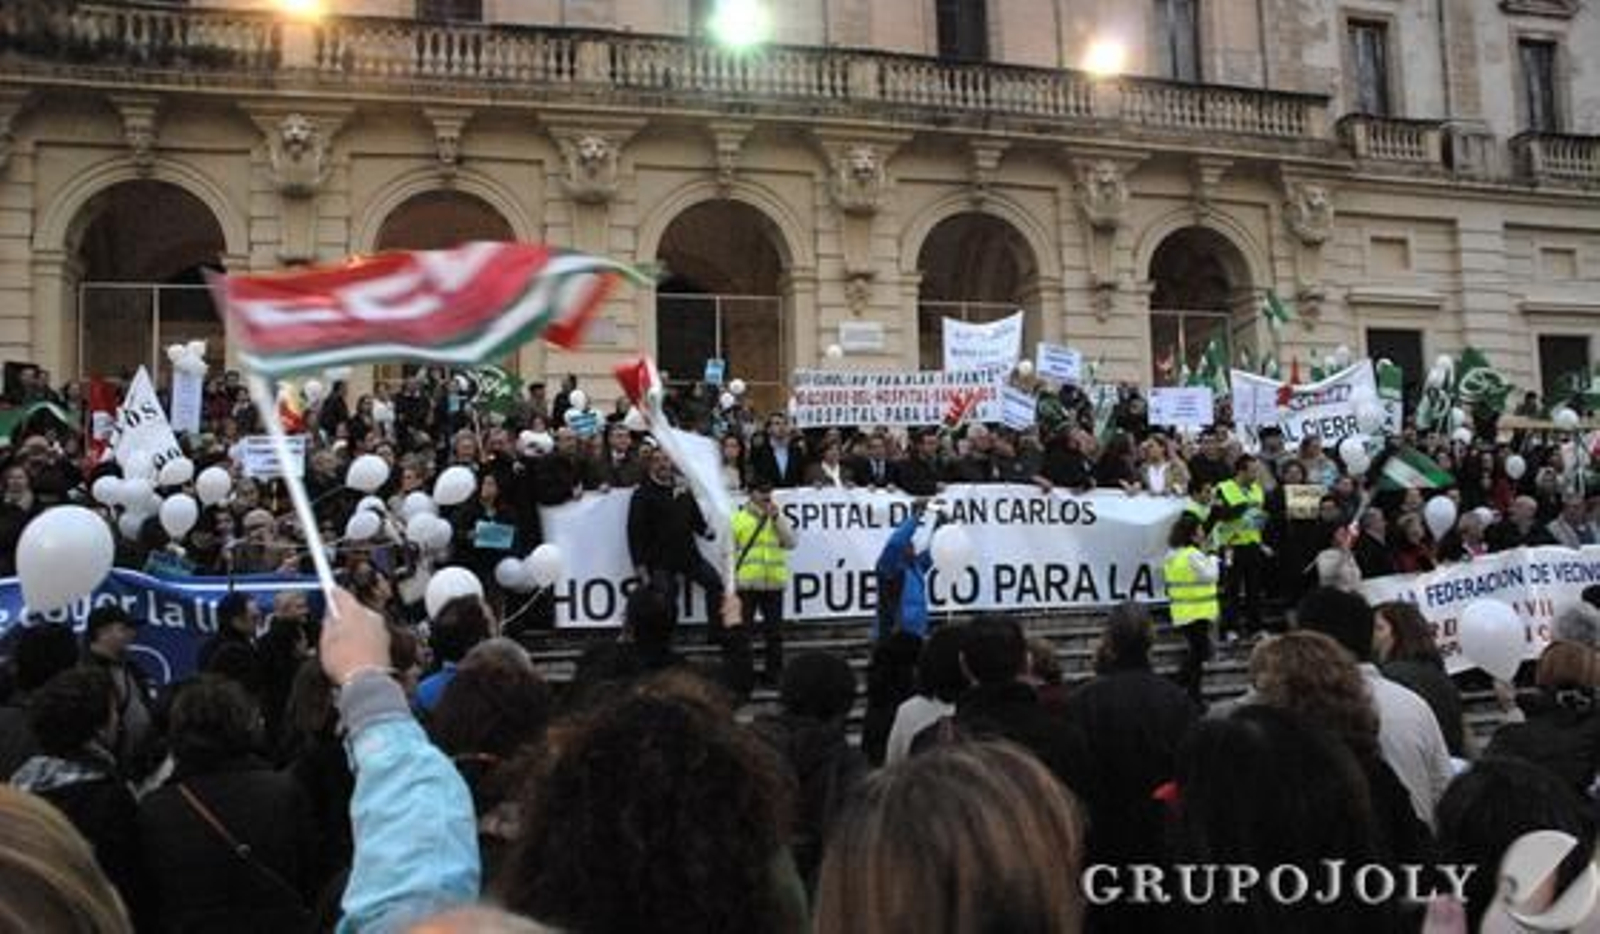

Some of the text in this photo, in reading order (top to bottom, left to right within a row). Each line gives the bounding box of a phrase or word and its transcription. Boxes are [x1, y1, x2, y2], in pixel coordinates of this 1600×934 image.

[1302, 414, 1361, 440] CIERR
[783, 502, 879, 530] SPITAL
[995, 499, 1097, 526] CARLOS
[993, 562, 1099, 603] PARA
[1108, 562, 1155, 601] LA
[1529, 562, 1552, 585] DE
[146, 589, 186, 628] la
